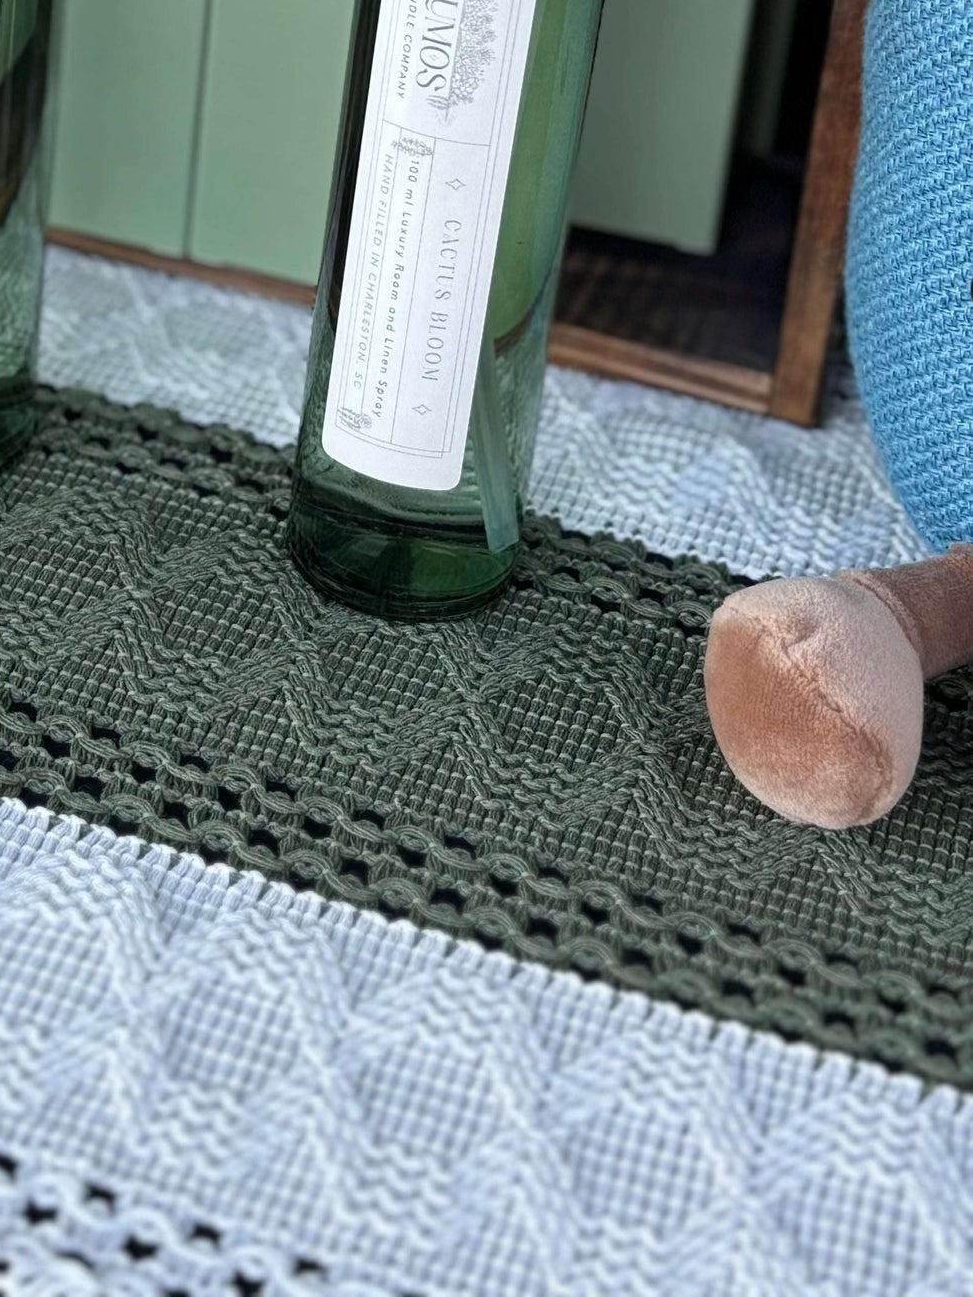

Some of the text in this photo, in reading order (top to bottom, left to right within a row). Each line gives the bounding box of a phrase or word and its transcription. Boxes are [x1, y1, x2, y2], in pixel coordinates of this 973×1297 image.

[397, 34, 412, 98] COMPANY
[381, 154, 394, 194] HAND
[374, 200, 388, 246] FILLED
[370, 252, 381, 266] IN
[372, 160, 420, 418] 100 ml Luxury Room and Linen Spray
[422, 220, 462, 380] CACTUS BLOOM
[352, 372, 362, 388] SC
